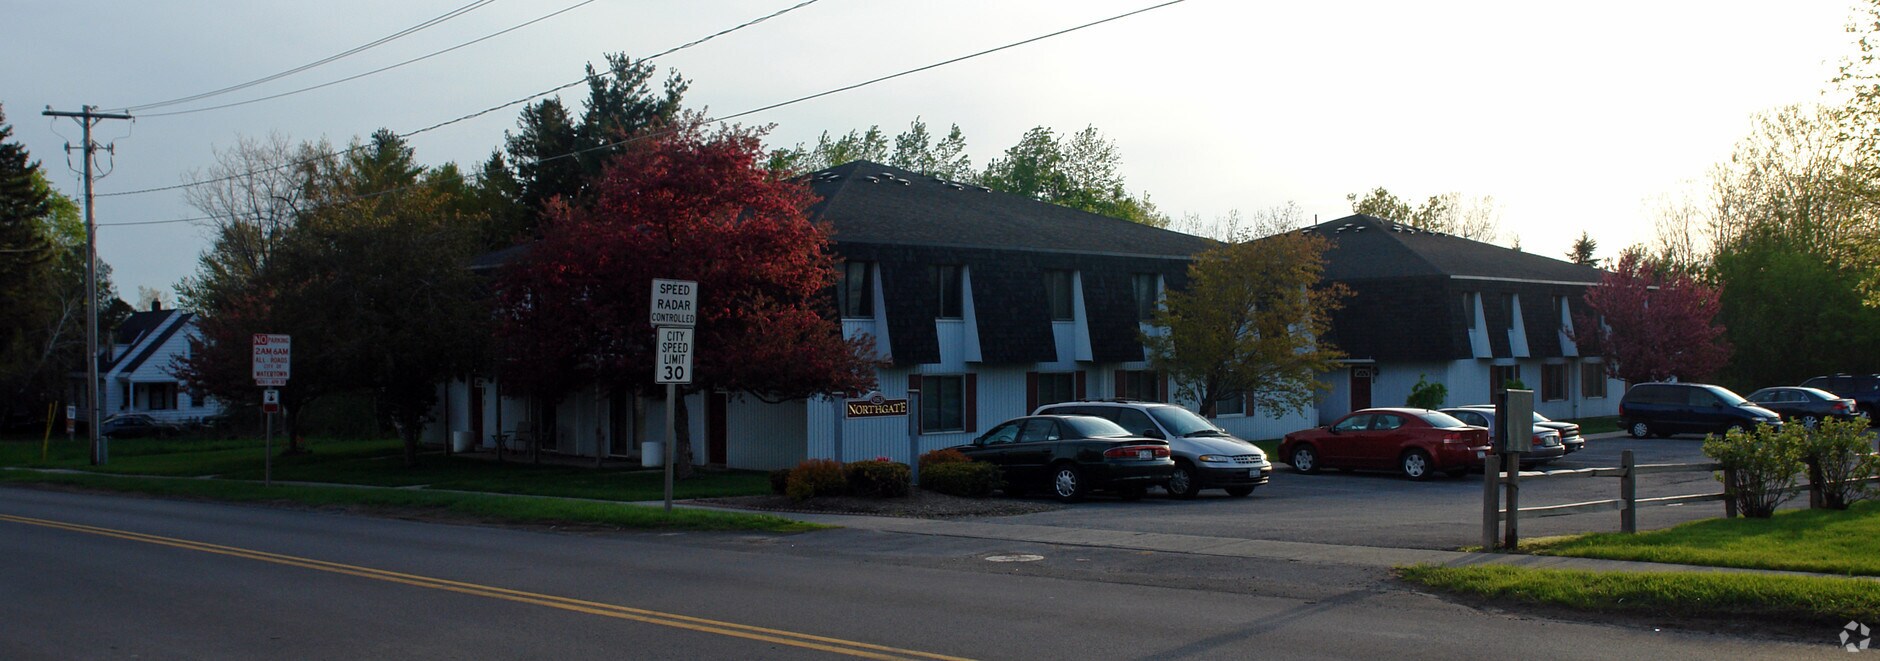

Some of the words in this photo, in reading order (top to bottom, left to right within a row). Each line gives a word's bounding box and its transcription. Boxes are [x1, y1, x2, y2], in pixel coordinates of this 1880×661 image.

[660, 283, 690, 295] SPEED
[657, 299, 691, 310] RADAR
[651, 312, 695, 323] CONTROLLED
[254, 335, 267, 344] NO
[667, 331, 685, 341] CITY
[255, 347, 272, 355] 2AM
[273, 347, 289, 355] 6AM
[662, 342, 688, 353] SPEED
[664, 354, 685, 364] LIMIT
[664, 366, 684, 380] 30
[849, 402, 906, 415] NORTHGATE
